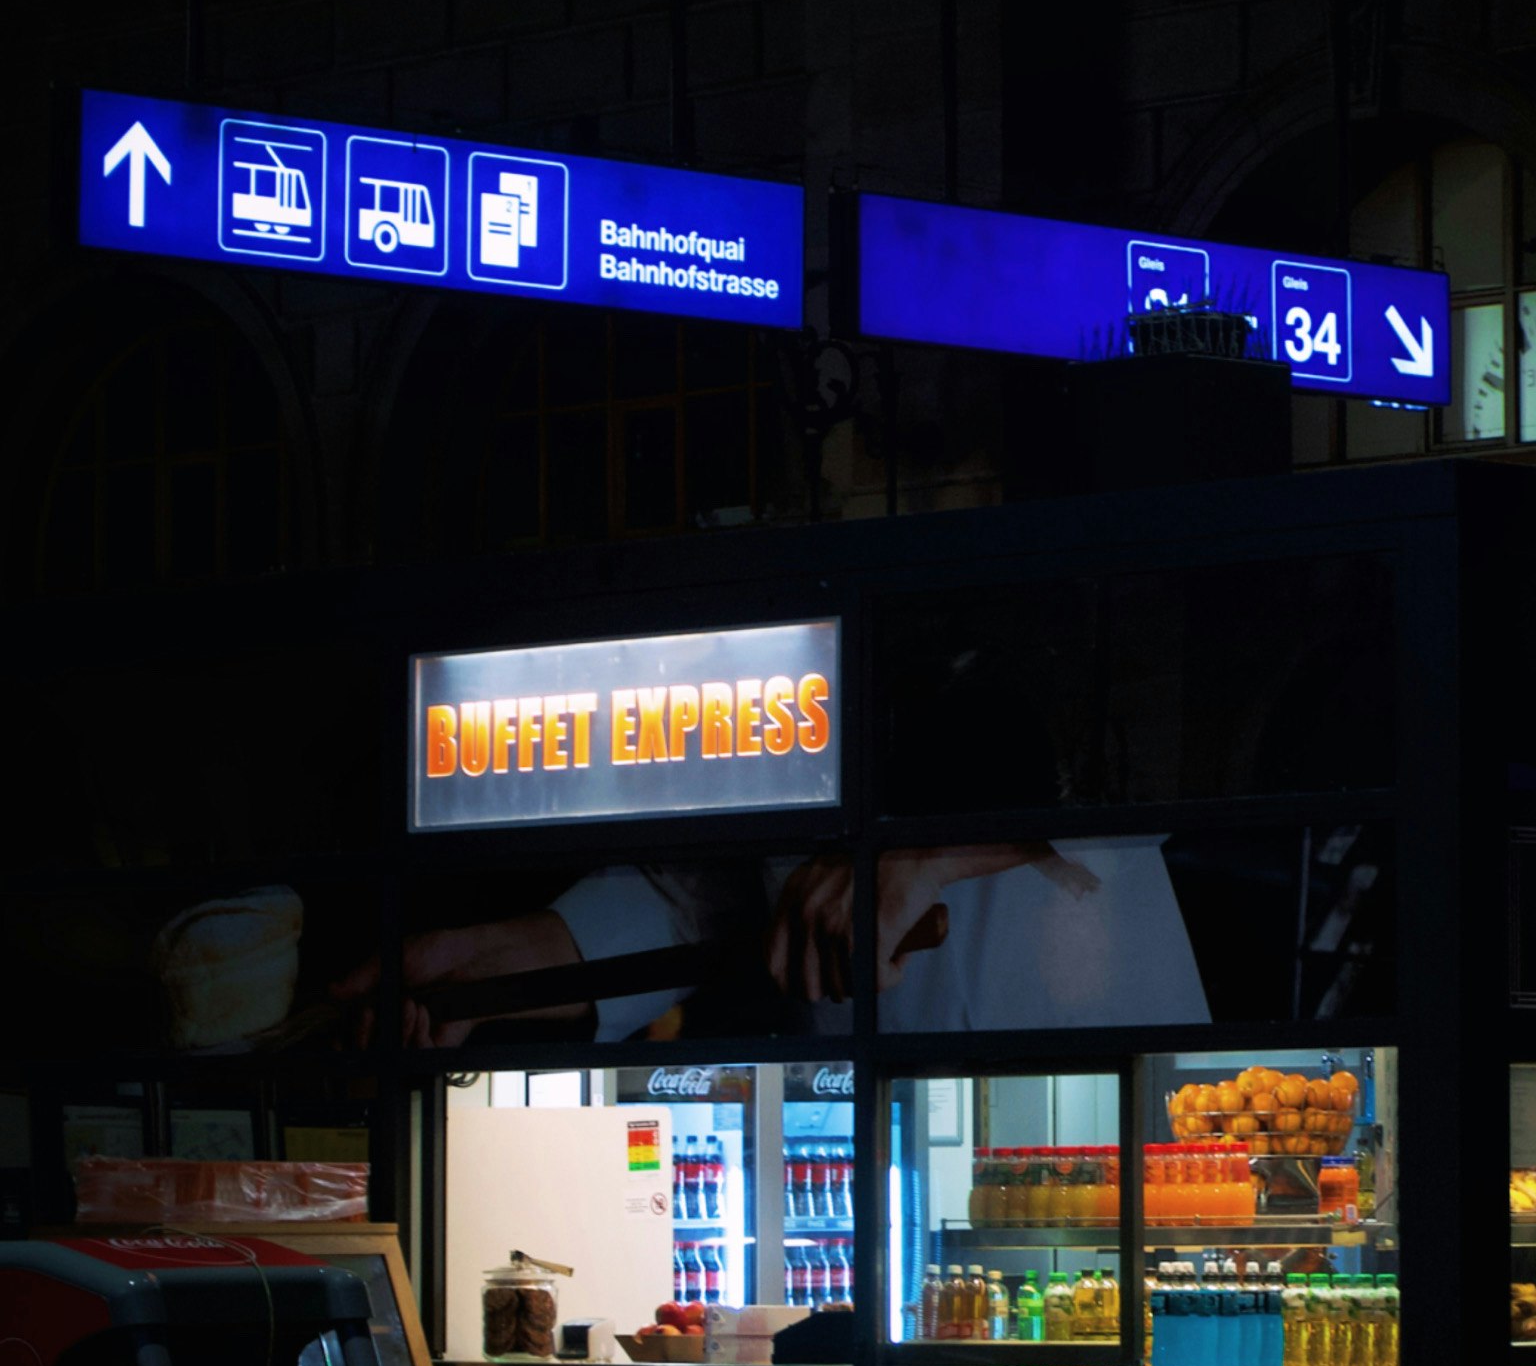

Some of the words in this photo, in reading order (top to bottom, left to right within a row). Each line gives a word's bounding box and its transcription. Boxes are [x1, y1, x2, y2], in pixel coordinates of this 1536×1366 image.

[600, 219, 745, 263] Bahnhofquai
[1138, 255, 1165, 272] Gleis
[600, 253, 780, 299] Bahnhofstrasse
[1282, 276, 1309, 291] Gleis
[1285, 307, 1341, 365] 34
[426, 692, 598, 778] BUFFET
[611, 672, 830, 766] EXPRESS
